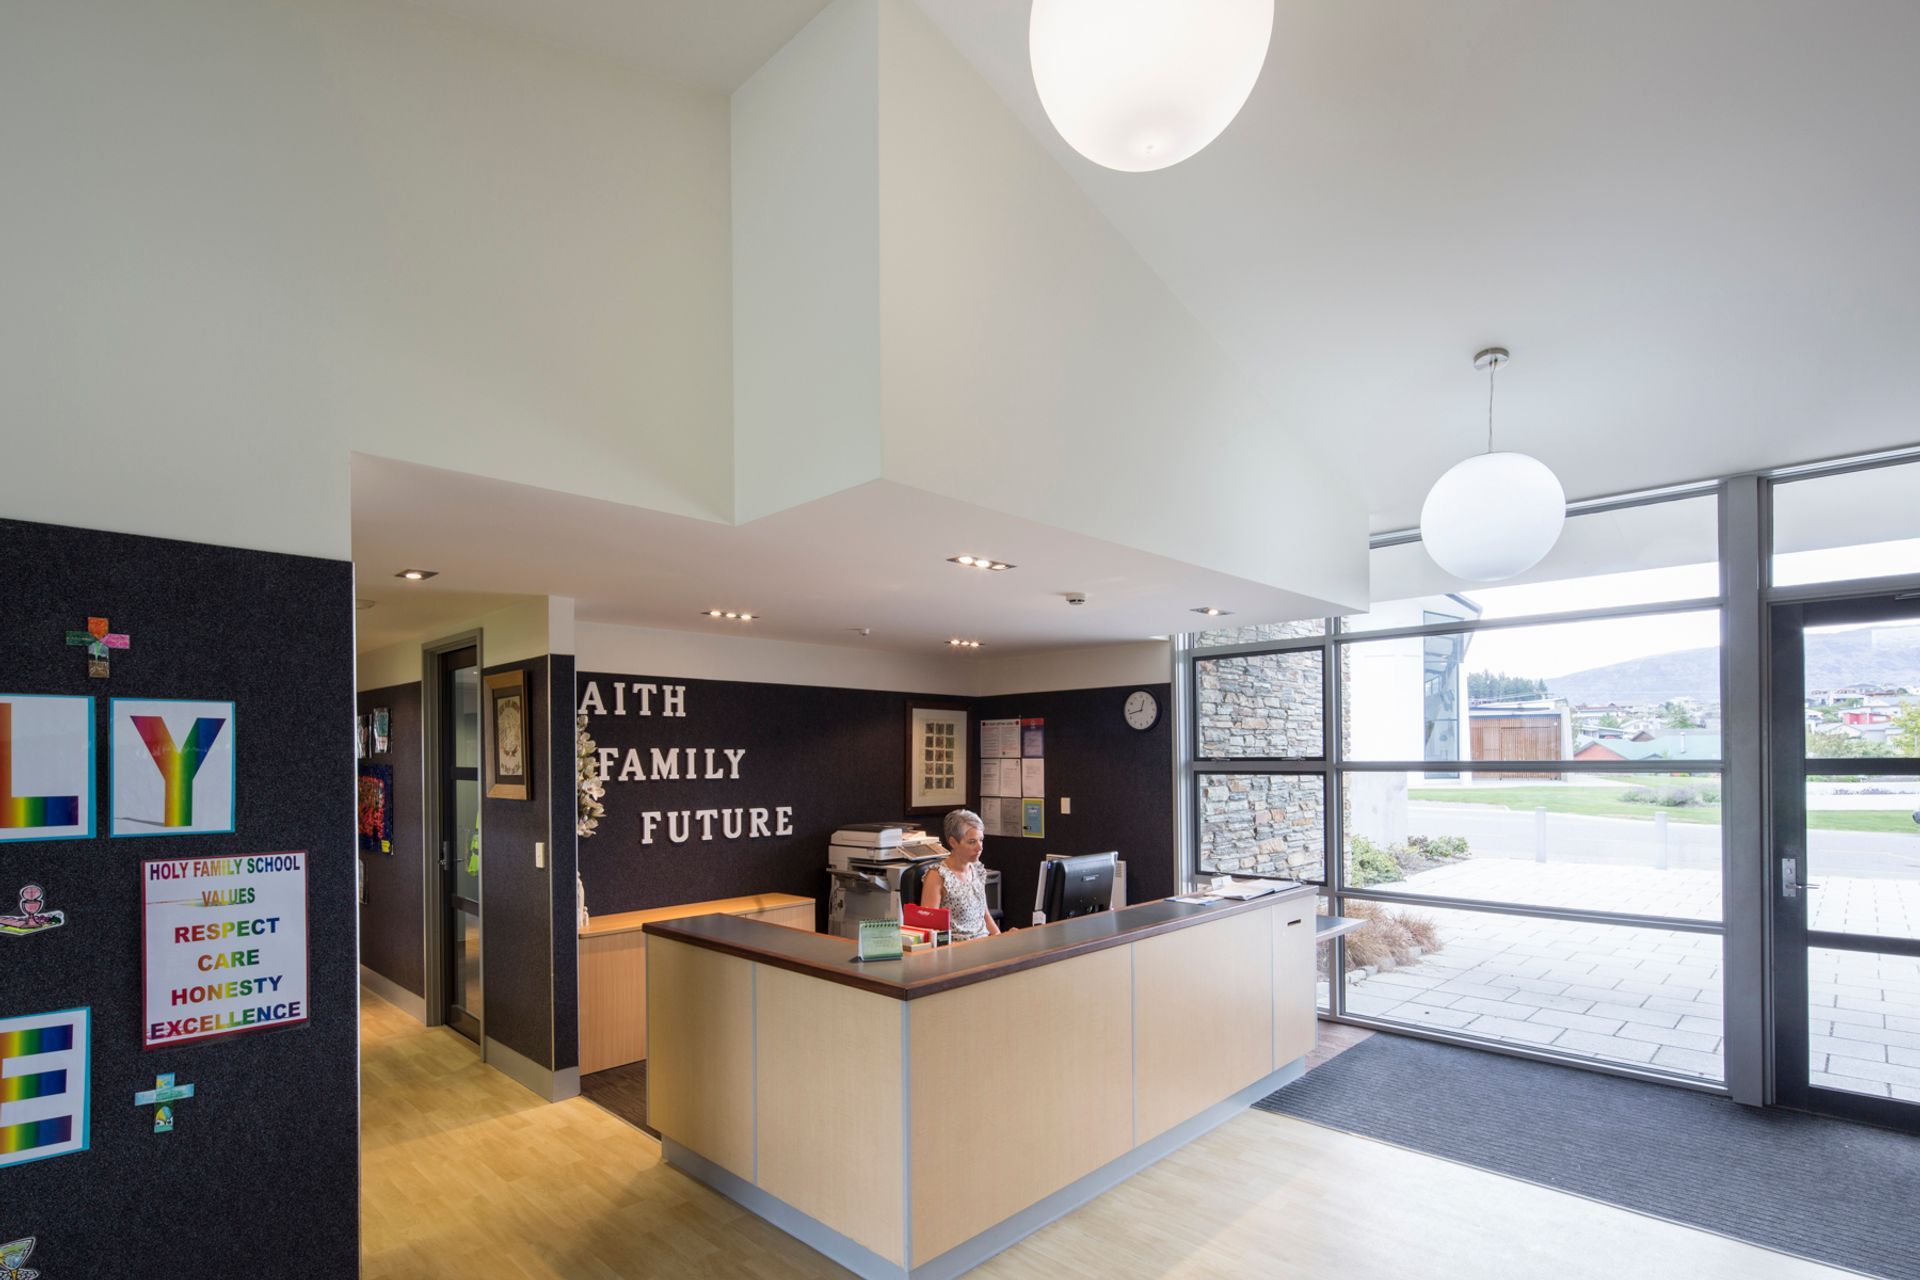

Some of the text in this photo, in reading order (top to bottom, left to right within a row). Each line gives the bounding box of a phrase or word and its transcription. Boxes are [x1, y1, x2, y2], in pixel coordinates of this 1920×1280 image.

[598, 748, 746, 781] FAMILY
[641, 806, 793, 844] FUTURE
[150, 855, 300, 880] HOLY FAMILY SCHOOL
[202, 887, 256, 907] VALUES
[175, 917, 280, 944] RESPECT
[198, 949, 260, 972] CARE
[171, 975, 283, 1006] HONESTY
[150, 1001, 301, 1040] EXCELLENCE
